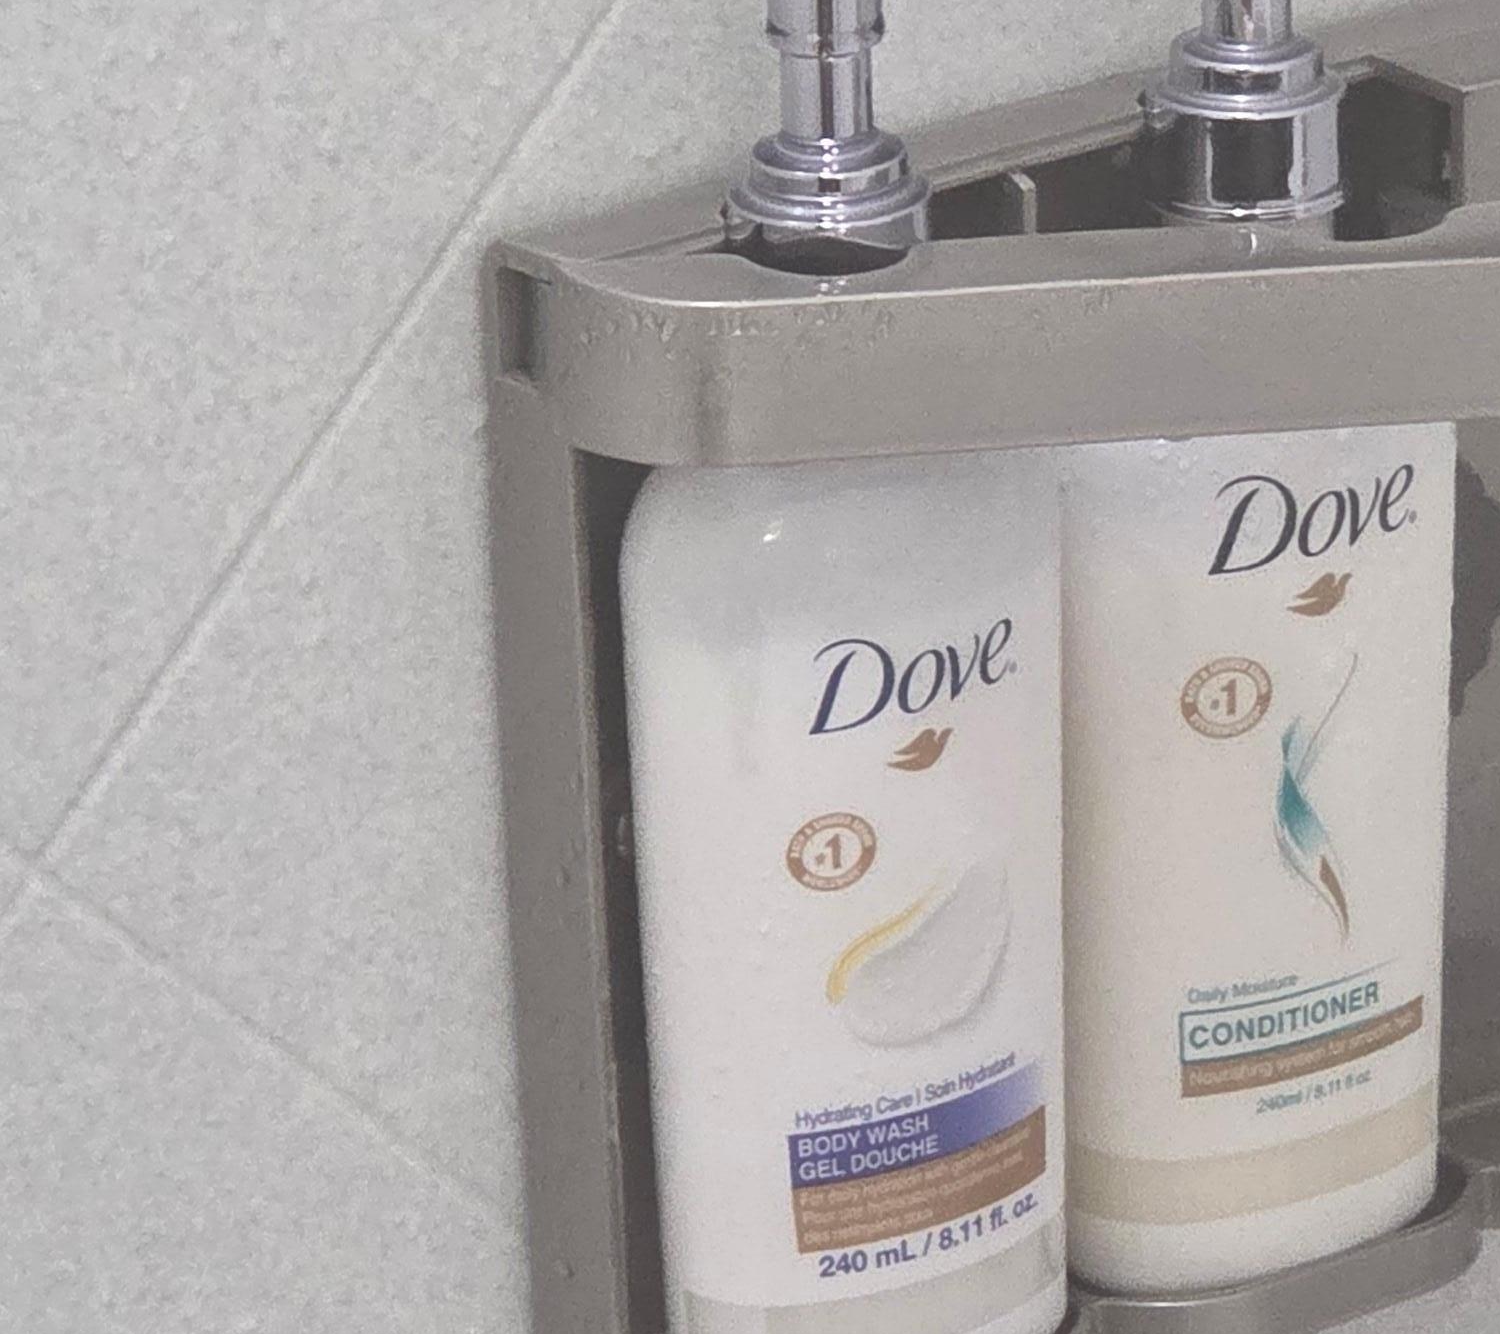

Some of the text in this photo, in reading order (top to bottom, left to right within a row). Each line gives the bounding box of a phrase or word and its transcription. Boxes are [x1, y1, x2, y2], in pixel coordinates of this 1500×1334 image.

[1208, 463, 1414, 575] Dove
[808, 617, 1014, 735] Dove
[1188, 981, 1379, 1050] CONDITIONER
[795, 1104, 873, 1130] Hydrating
[876, 1095, 913, 1115] Care
[924, 1078, 956, 1102] Soin
[798, 1113, 929, 1158] BODY WASH
[798, 1134, 939, 1181] GEL DOUCHE
[819, 1249, 868, 1277] 240
[876, 1239, 917, 1269] mL
[922, 1231, 933, 1257] /
[938, 1214, 982, 1251] 8.11
